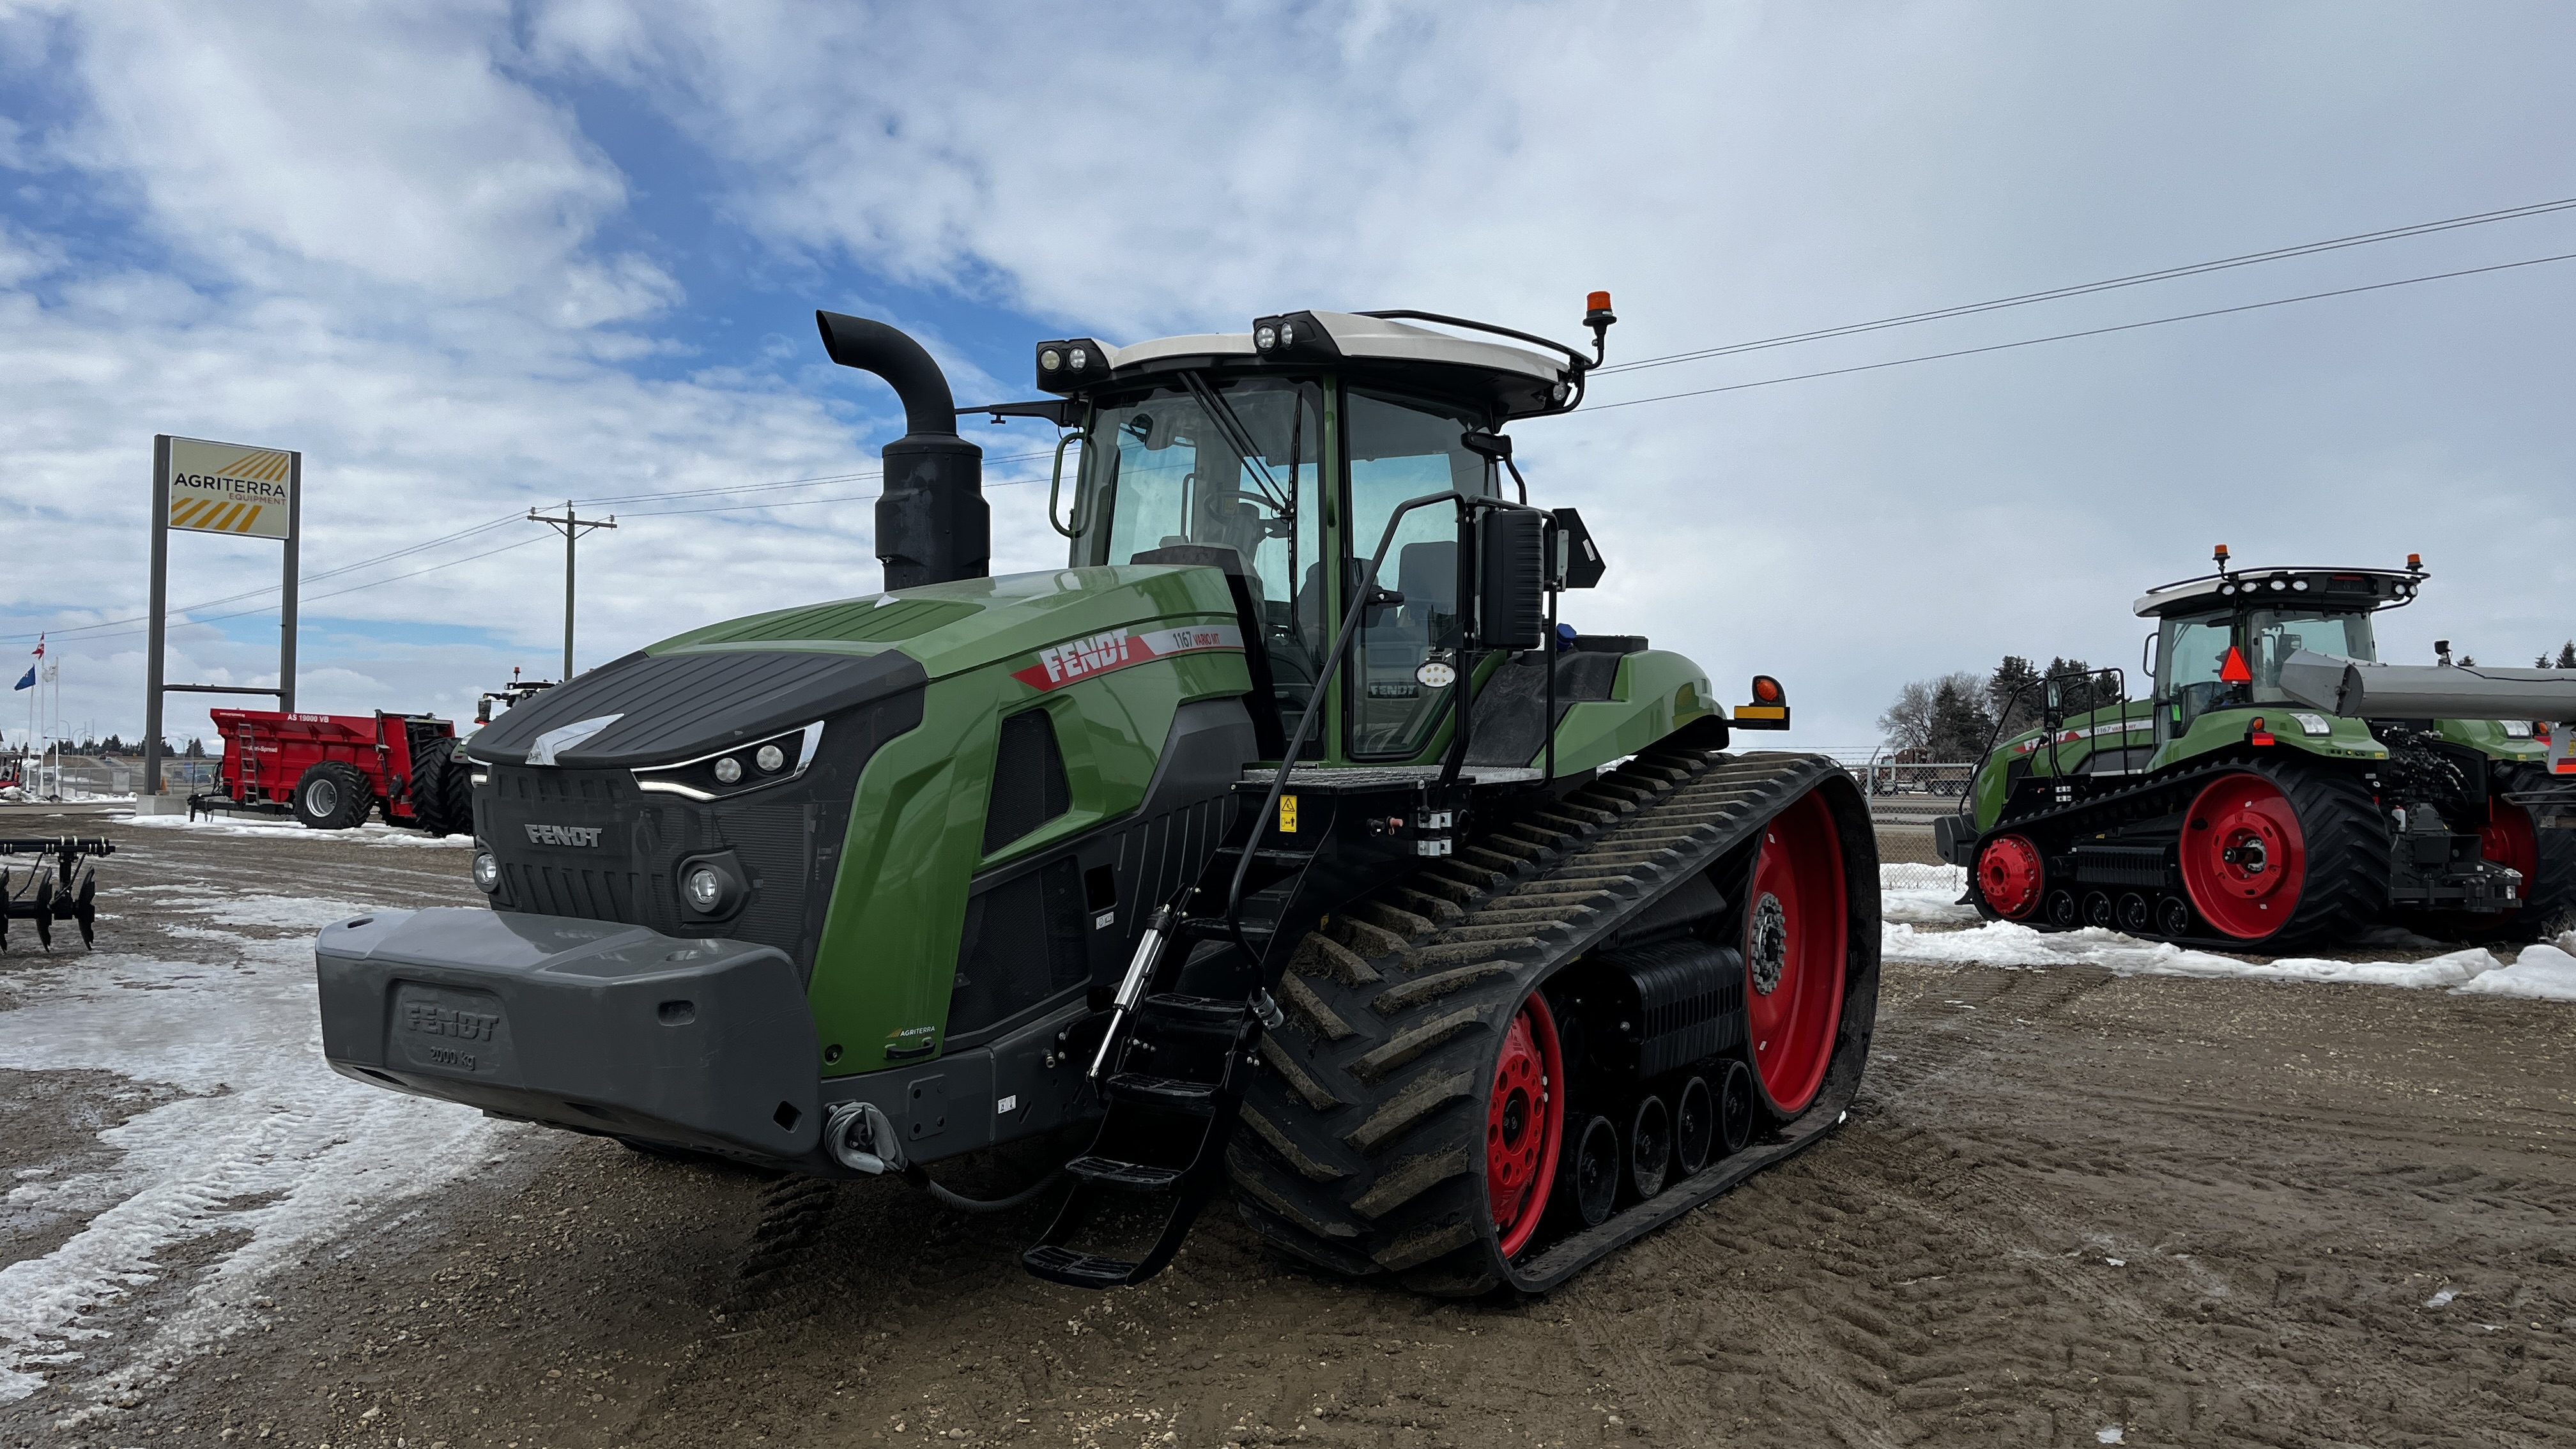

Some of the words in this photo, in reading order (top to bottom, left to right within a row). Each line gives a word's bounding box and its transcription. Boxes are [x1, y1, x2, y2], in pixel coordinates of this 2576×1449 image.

[174, 473, 286, 497] AGRITERRA
[229, 493, 287, 505] EQUIPMENT
[1172, 631, 1193, 649] 1167
[1193, 633, 1212, 647] VARIO
[1211, 633, 1221, 645] MT
[1039, 627, 1128, 683] FENDT
[1370, 685, 1417, 695] FENDT
[524, 824, 603, 848] FENDT
[403, 1003, 500, 1042] FENDT
[900, 1025, 935, 1037] AGRITERRA
[460, 1050, 477, 1071] kg
